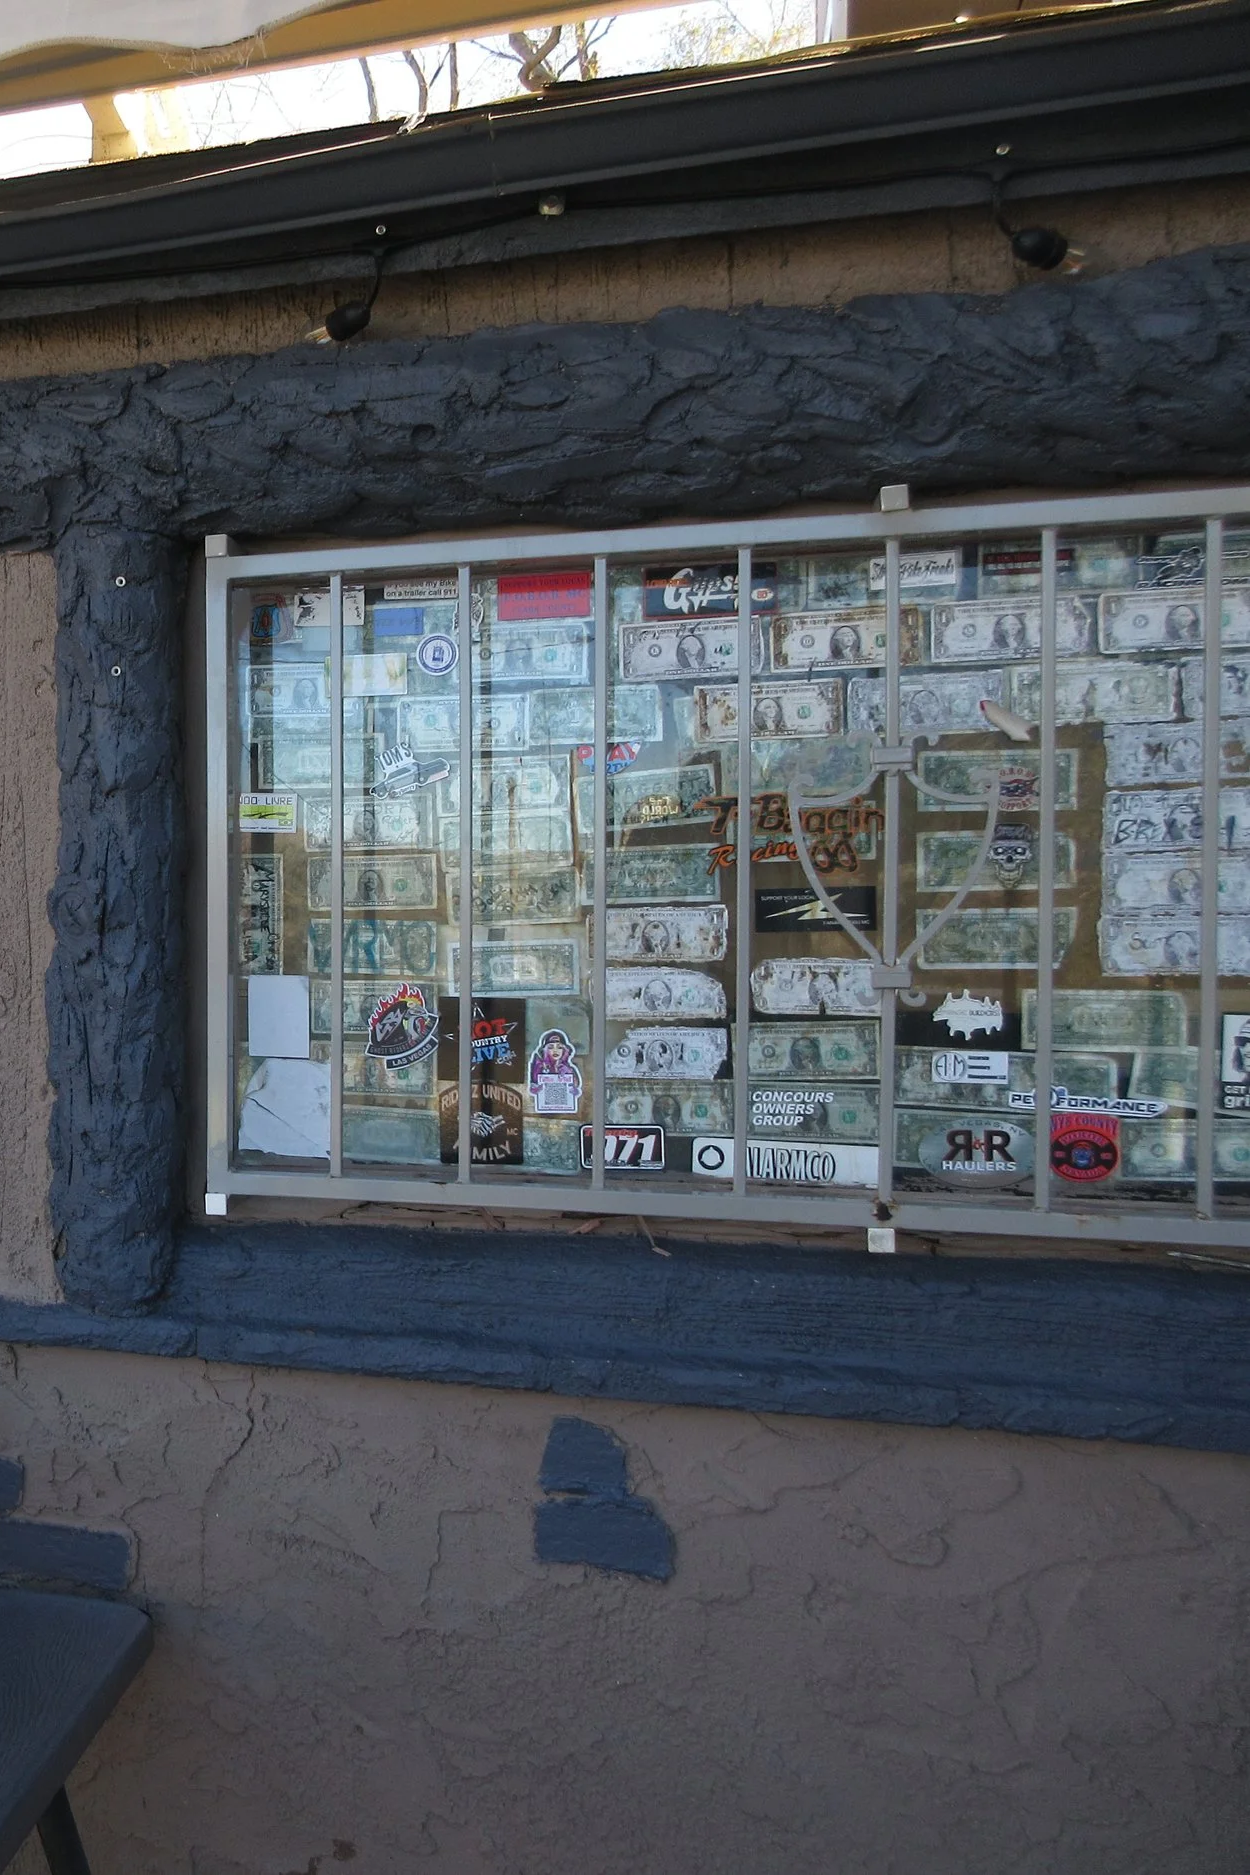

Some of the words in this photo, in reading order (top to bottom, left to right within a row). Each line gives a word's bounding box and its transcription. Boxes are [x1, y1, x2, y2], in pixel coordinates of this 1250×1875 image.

[444, 588, 457, 596] 911
[375, 741, 412, 771] TOM'S
[577, 742, 638, 761] PAY
[265, 796, 293, 805] LIVRE
[707, 839, 799, 876] Rcing
[392, 1058, 408, 1066] LAS
[409, 1044, 432, 1061] VEGAS
[441, 1085, 479, 1111] RIDZ
[482, 1085, 521, 1111] UNITED
[751, 1091, 834, 1103] CONCOURS
[751, 1103, 815, 1115] OWNERS
[1011, 1093, 1162, 1114] PEFORMANCE
[752, 1115, 804, 1127] GROUP
[506, 1128, 519, 1136] MC
[942, 1160, 1017, 1172] HAULERS
